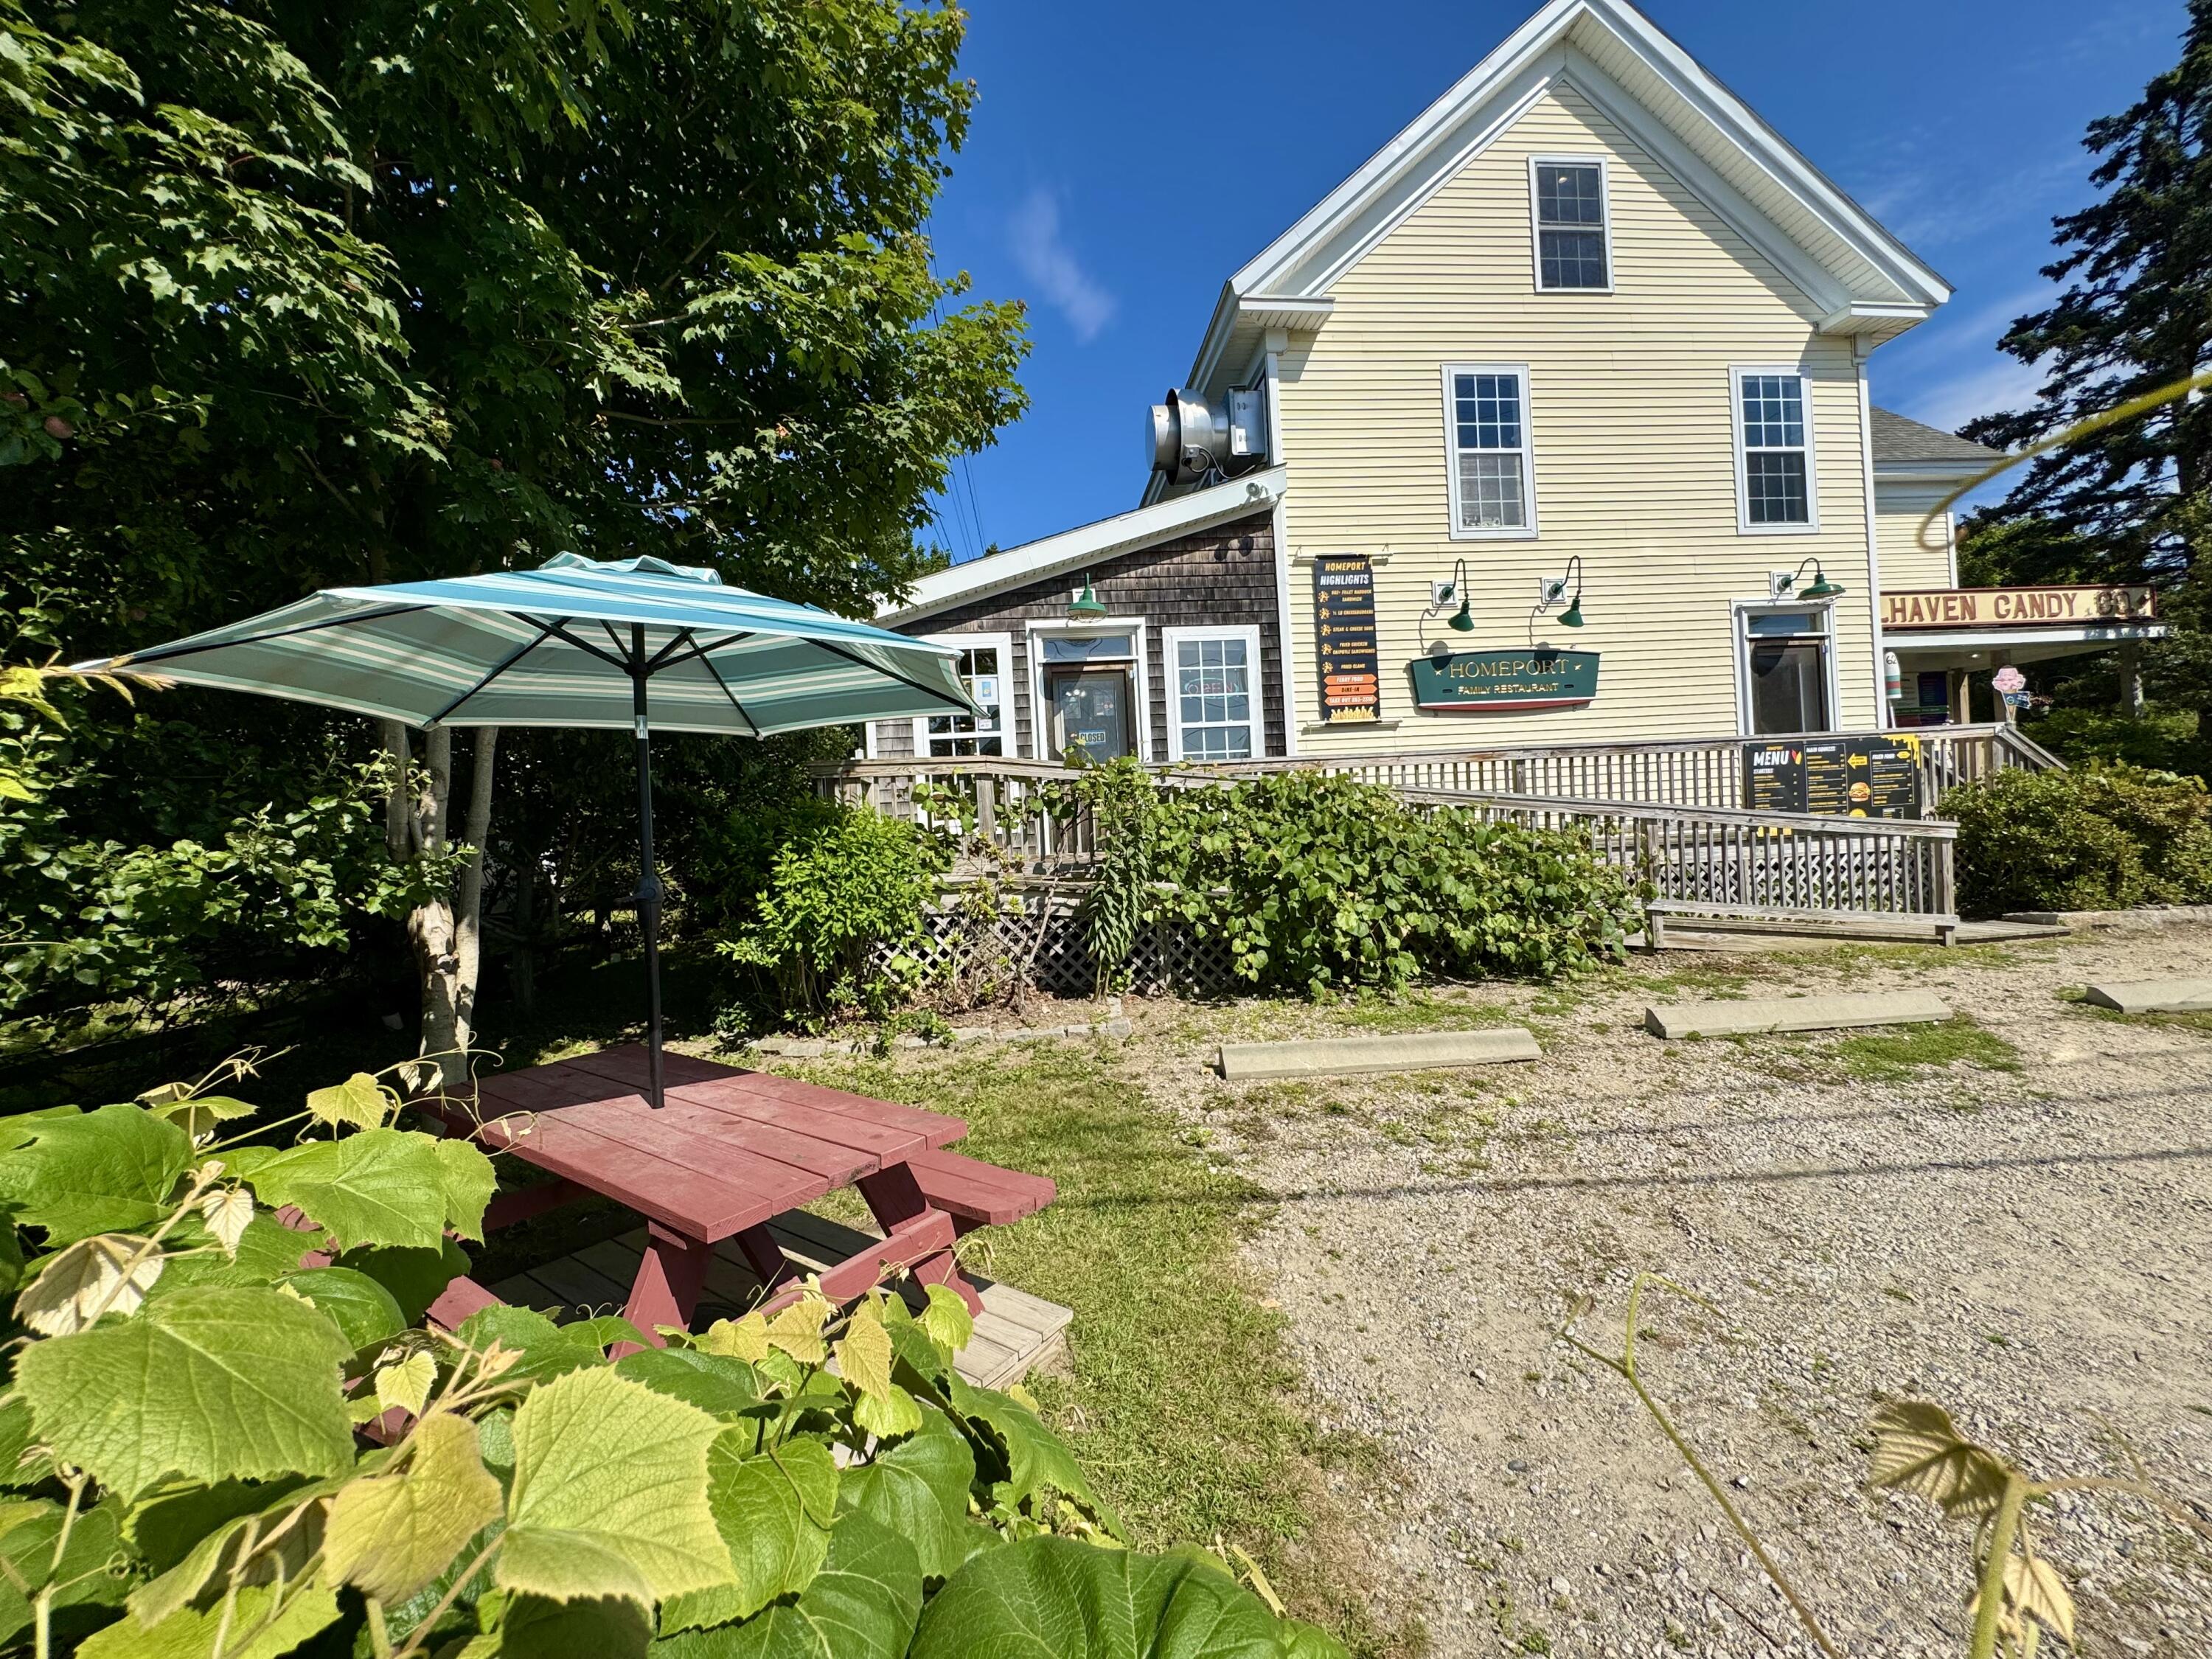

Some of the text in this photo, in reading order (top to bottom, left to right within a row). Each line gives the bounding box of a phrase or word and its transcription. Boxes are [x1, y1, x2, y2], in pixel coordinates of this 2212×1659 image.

[1325, 562, 1366, 571] HOMEPORT
[1320, 574, 1369, 585] HIGHLIGHTS
[1994, 593, 2078, 619] CANDY
[1885, 655, 1897, 664] 62
[1450, 659, 1569, 678] HOMEPORT
[1188, 683, 1233, 695] OPEN
[1458, 682, 1559, 695] FAMILY RESTAURANT
[1080, 732, 1105, 742] CLOSED
[1753, 751, 1790, 766] MENU
